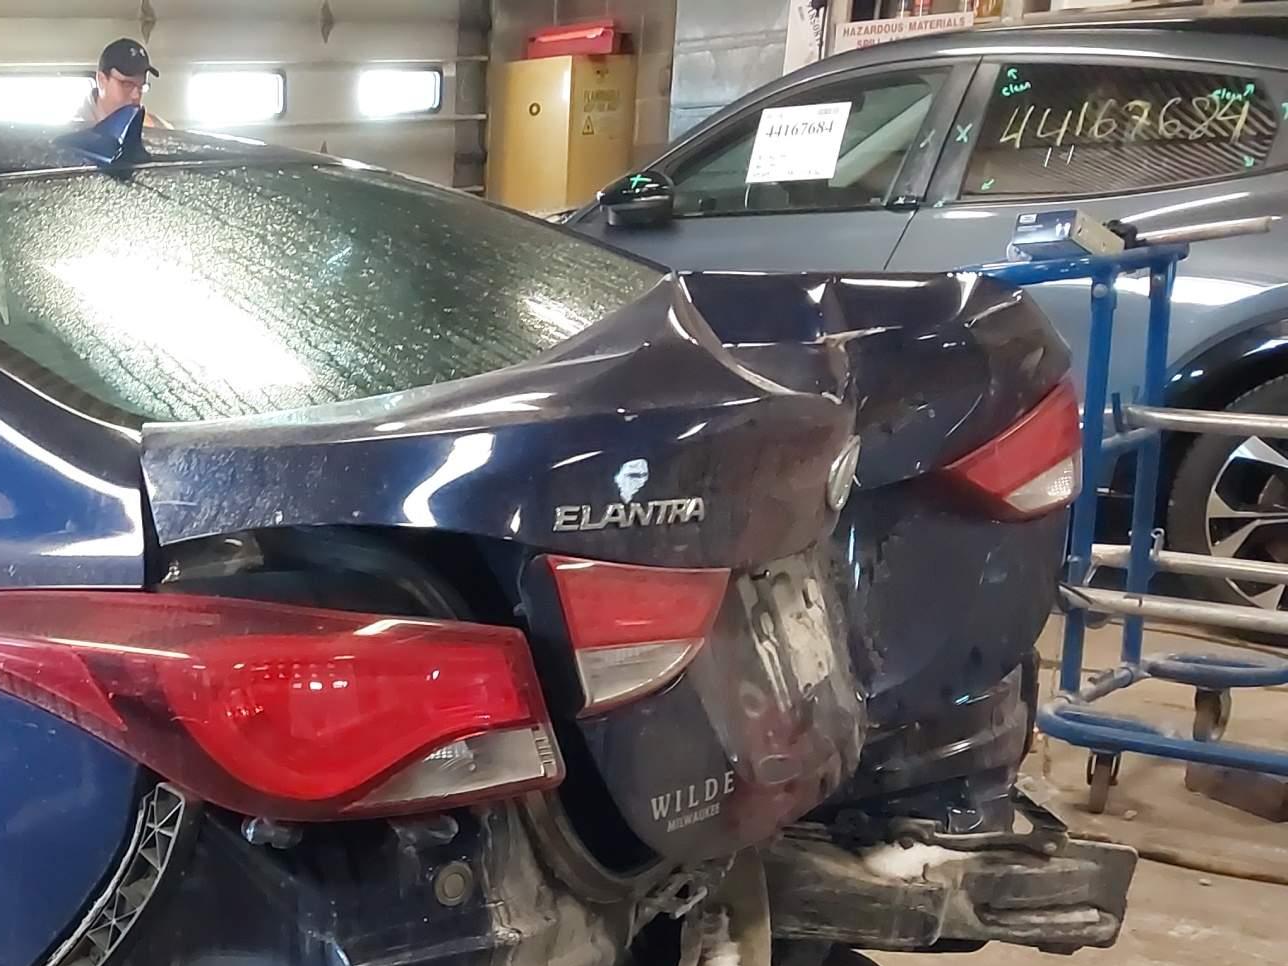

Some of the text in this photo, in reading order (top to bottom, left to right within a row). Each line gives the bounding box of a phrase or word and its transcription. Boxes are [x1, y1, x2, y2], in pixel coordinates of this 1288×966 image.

[842, 17, 966, 37] HAZARDOUS MATERIALS
[765, 120, 834, 138] 44167684
[999, 97, 1251, 149] 44167684
[553, 497, 705, 532] ELANTRA
[651, 770, 735, 820] WILDE
[667, 802, 721, 832] MILWAUKEE
